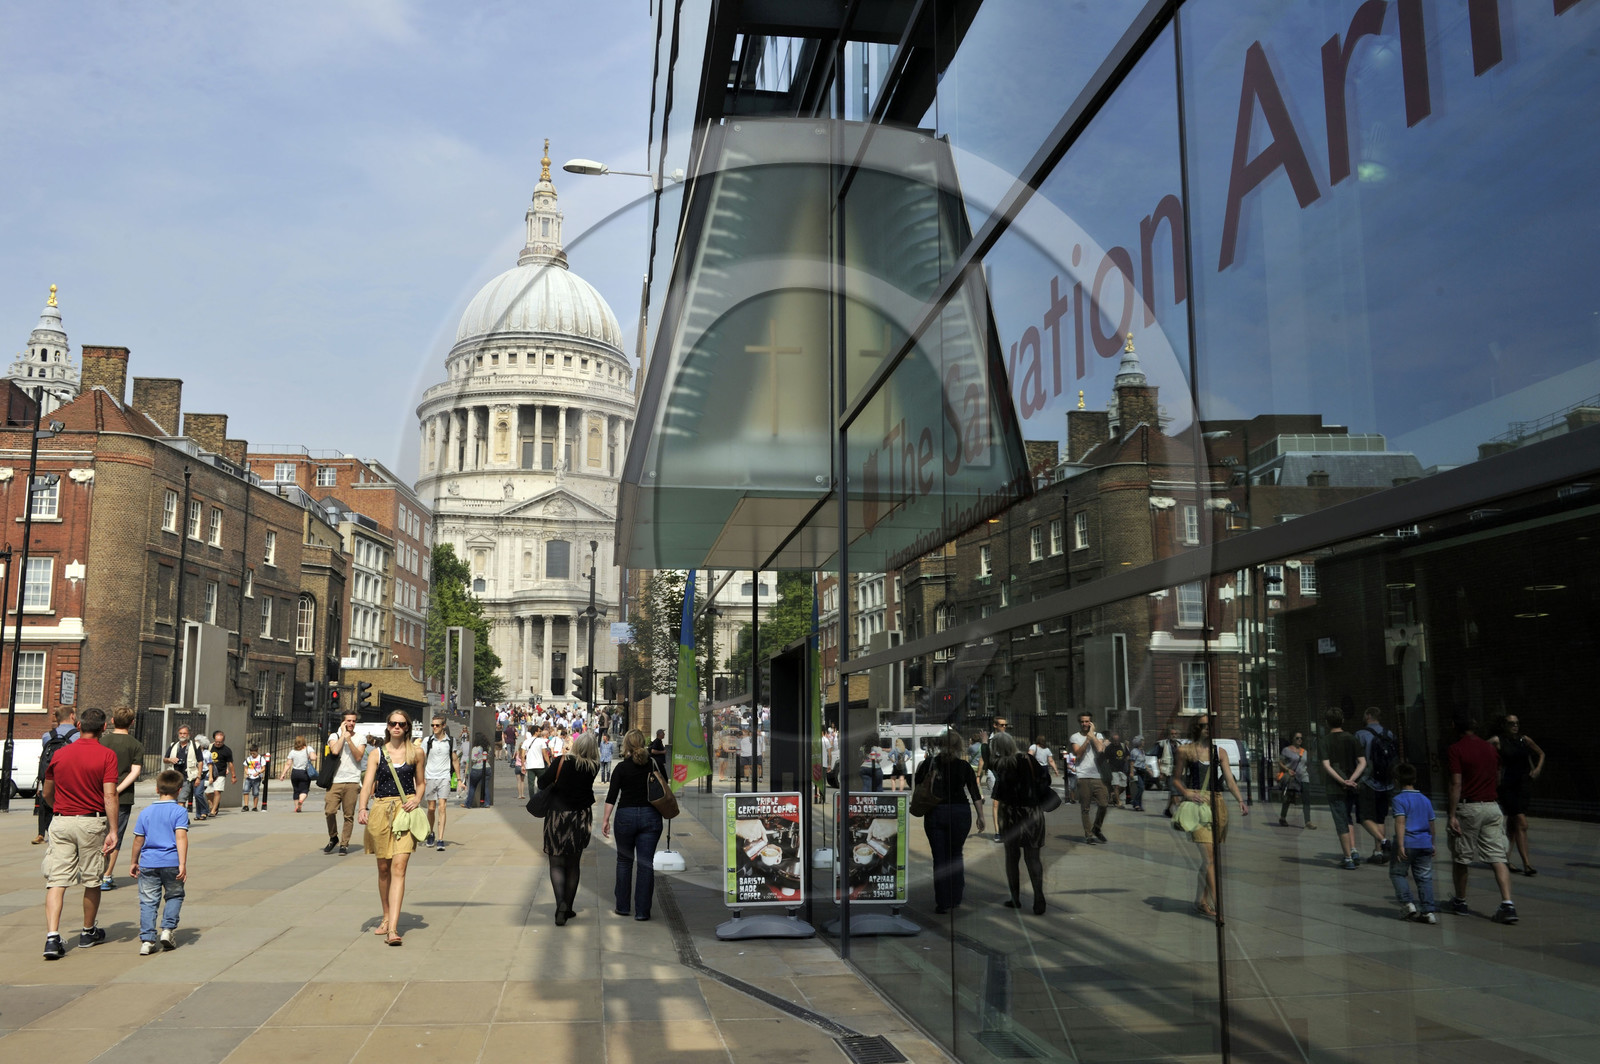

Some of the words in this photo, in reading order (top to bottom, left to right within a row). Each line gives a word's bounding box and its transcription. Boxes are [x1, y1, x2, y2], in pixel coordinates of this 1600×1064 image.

[883, 417, 934, 522] The
[885, 511, 945, 573] International
[756, 797, 779, 805] TRIPLE
[738, 806, 771, 814] CERTIFIED
[773, 805, 797, 813] COFFEE
[739, 877, 766, 885] BARISTA
